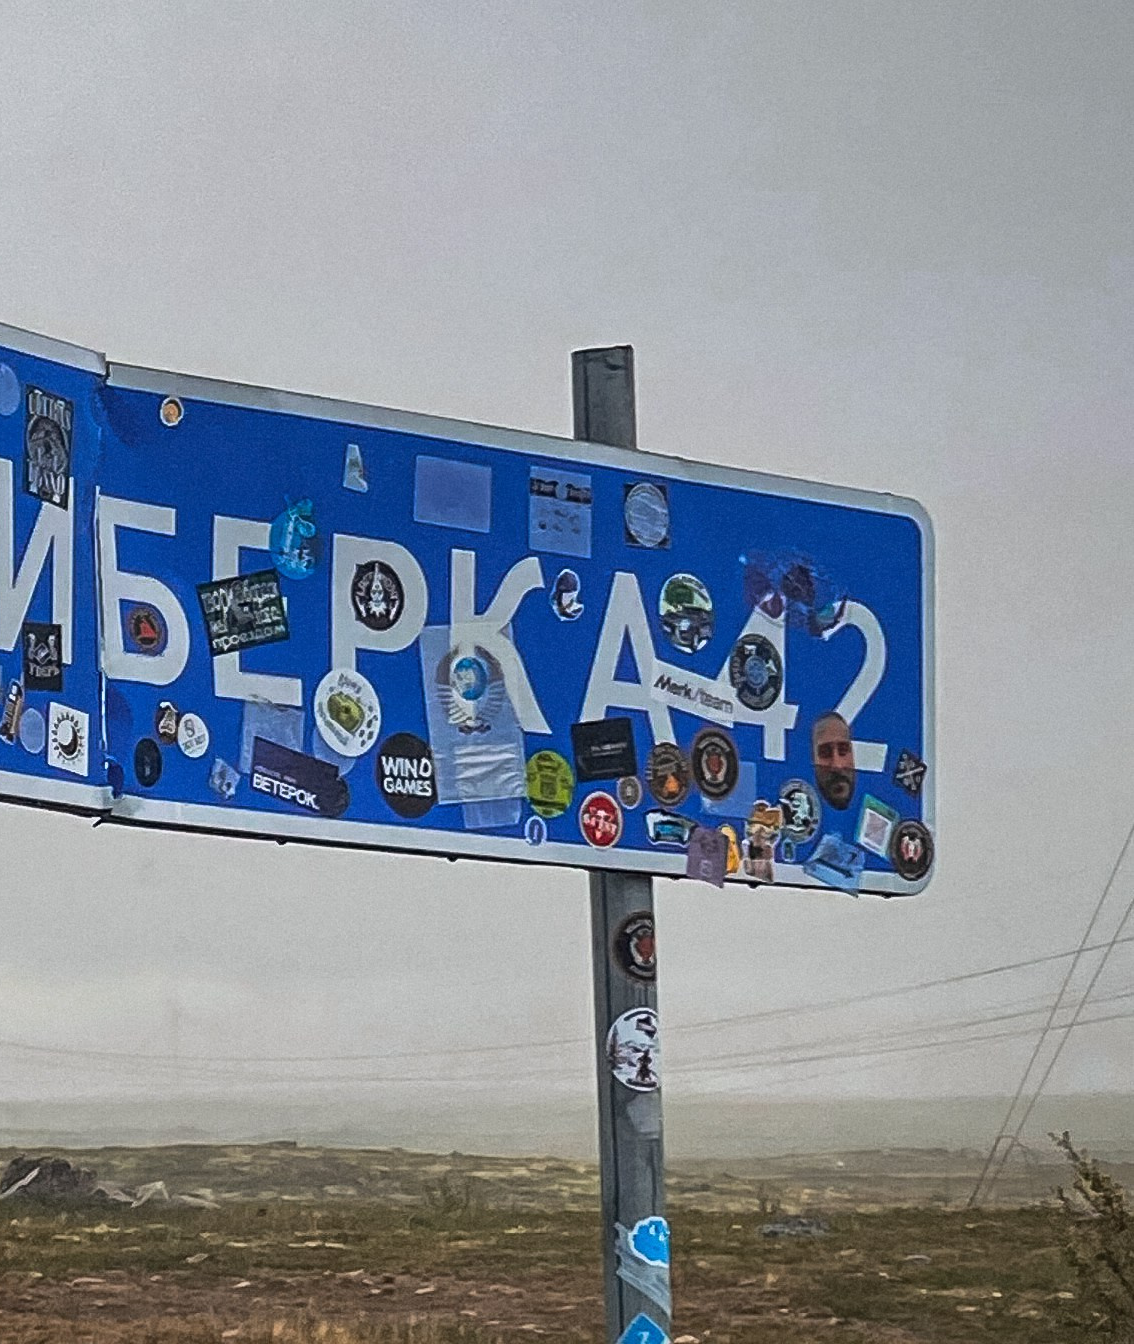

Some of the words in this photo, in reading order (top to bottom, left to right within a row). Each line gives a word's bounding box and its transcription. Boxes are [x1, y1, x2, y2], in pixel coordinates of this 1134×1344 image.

[709, 598, 889, 773] 42
[381, 756, 432, 778] WIND
[252, 772, 320, 810] ВЕТЕРОК
[383, 777, 433, 797] GAMES
